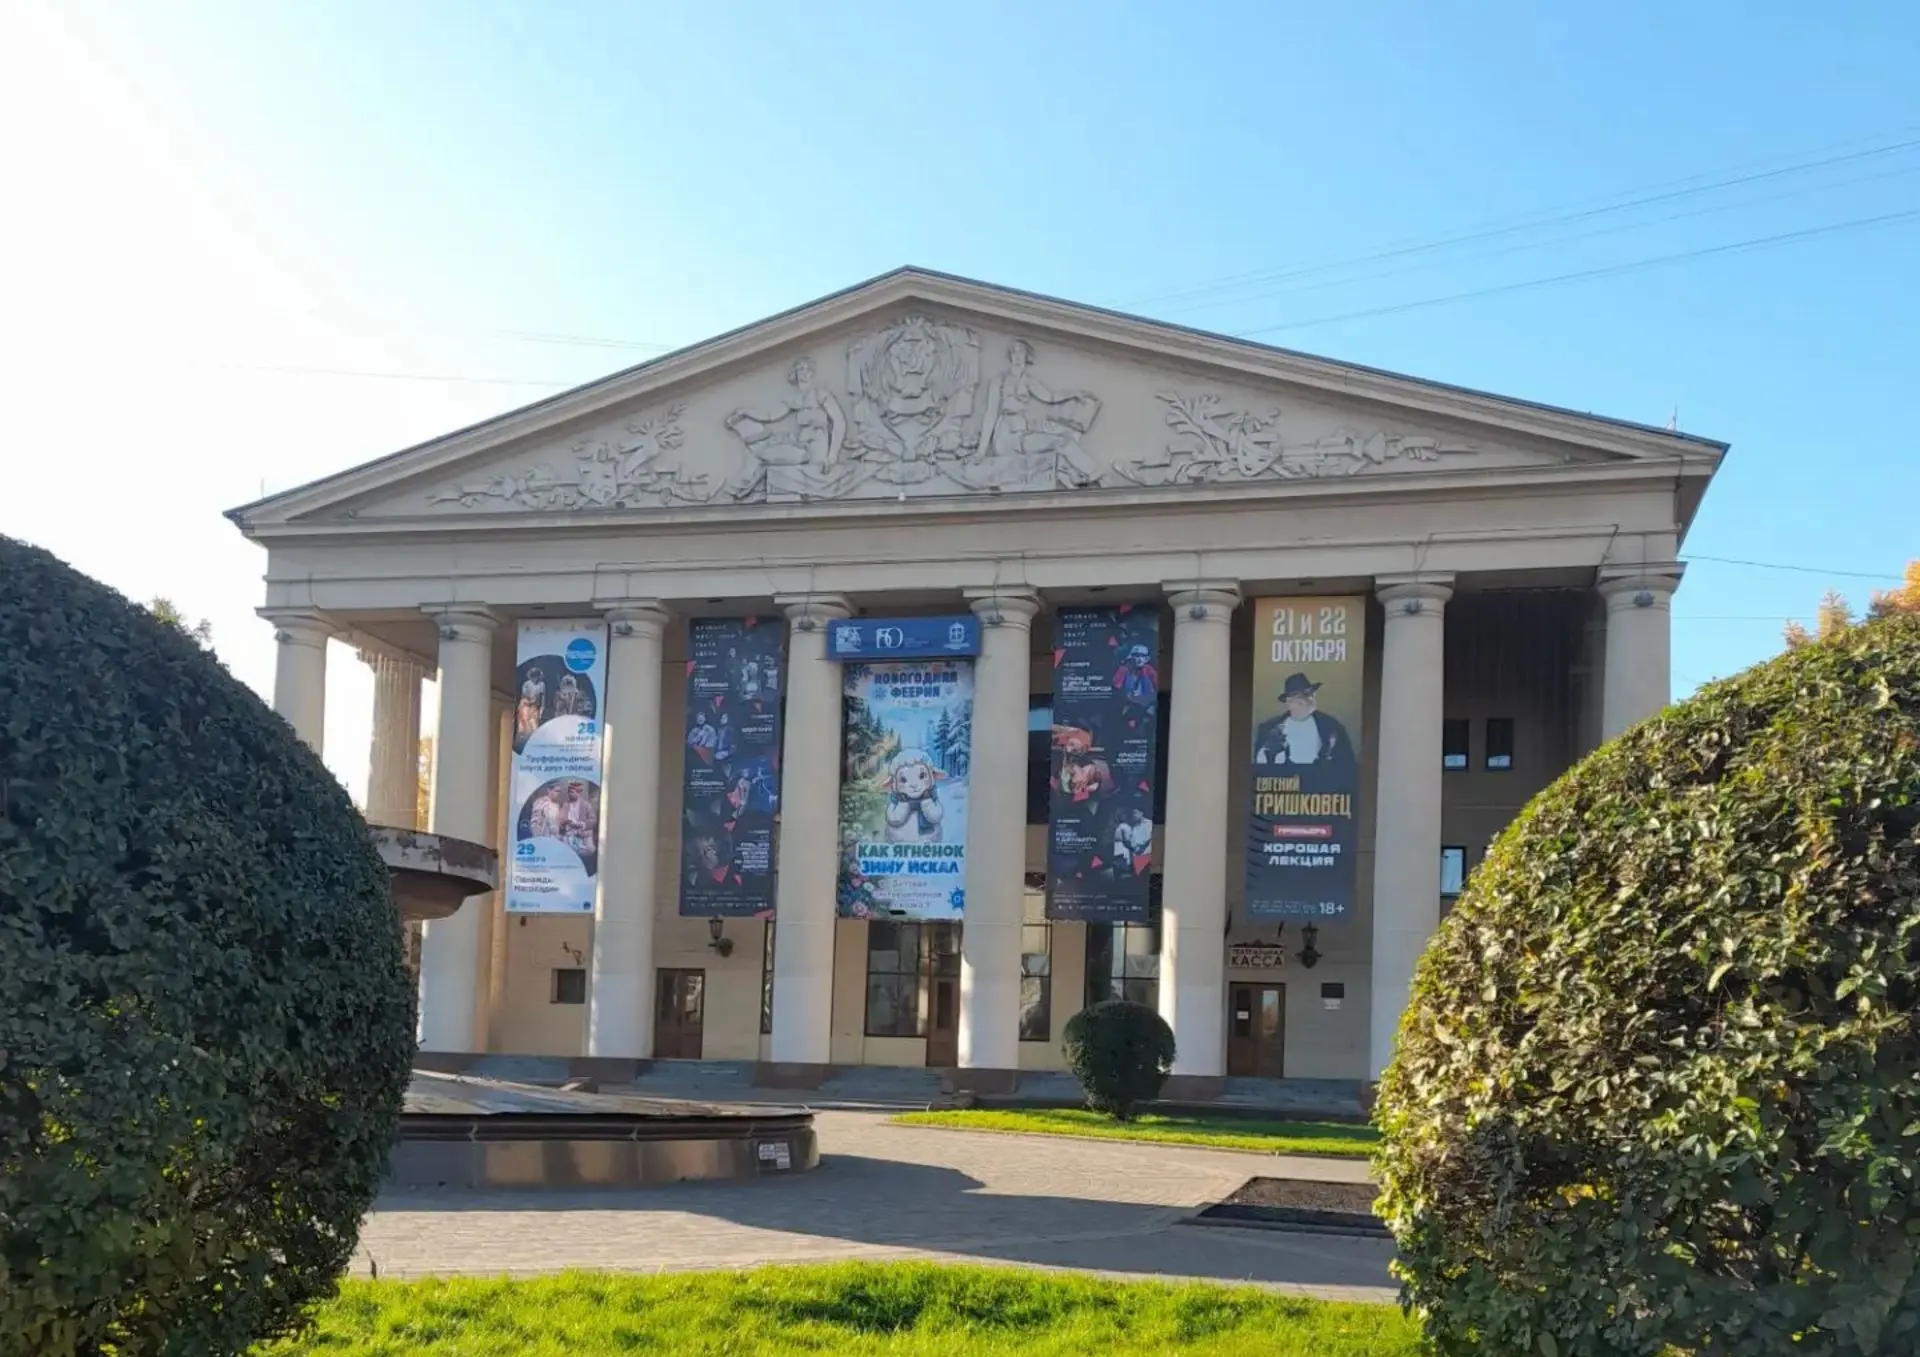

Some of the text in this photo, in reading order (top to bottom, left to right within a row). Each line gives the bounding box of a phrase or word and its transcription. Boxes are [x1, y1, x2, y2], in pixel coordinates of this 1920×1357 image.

[1273, 608, 1293, 635] 21
[1320, 607, 1346, 635] 22
[1272, 639, 1346, 662] ОКТЯБРЯ
[874, 671, 958, 685] НОВОГОДНЯЯ
[890, 686, 940, 698] ФЕЕРИЯ
[577, 722, 596, 734] 28
[1257, 775, 1300, 792] ЕВГЕНИЙ
[1255, 794, 1351, 819] ГРИШКОВЕЦ
[517, 843, 536, 855] 29
[858, 844, 889, 858] КАК
[1263, 843, 1341, 854] ХОРОШАЯ
[861, 860, 959, 873] ЗИМУ ИСКАЛ
[1269, 855, 1334, 867] ЛЕКЦИЯ
[1319, 902, 1344, 914] 18+
[1232, 955, 1283, 966] КАССА
